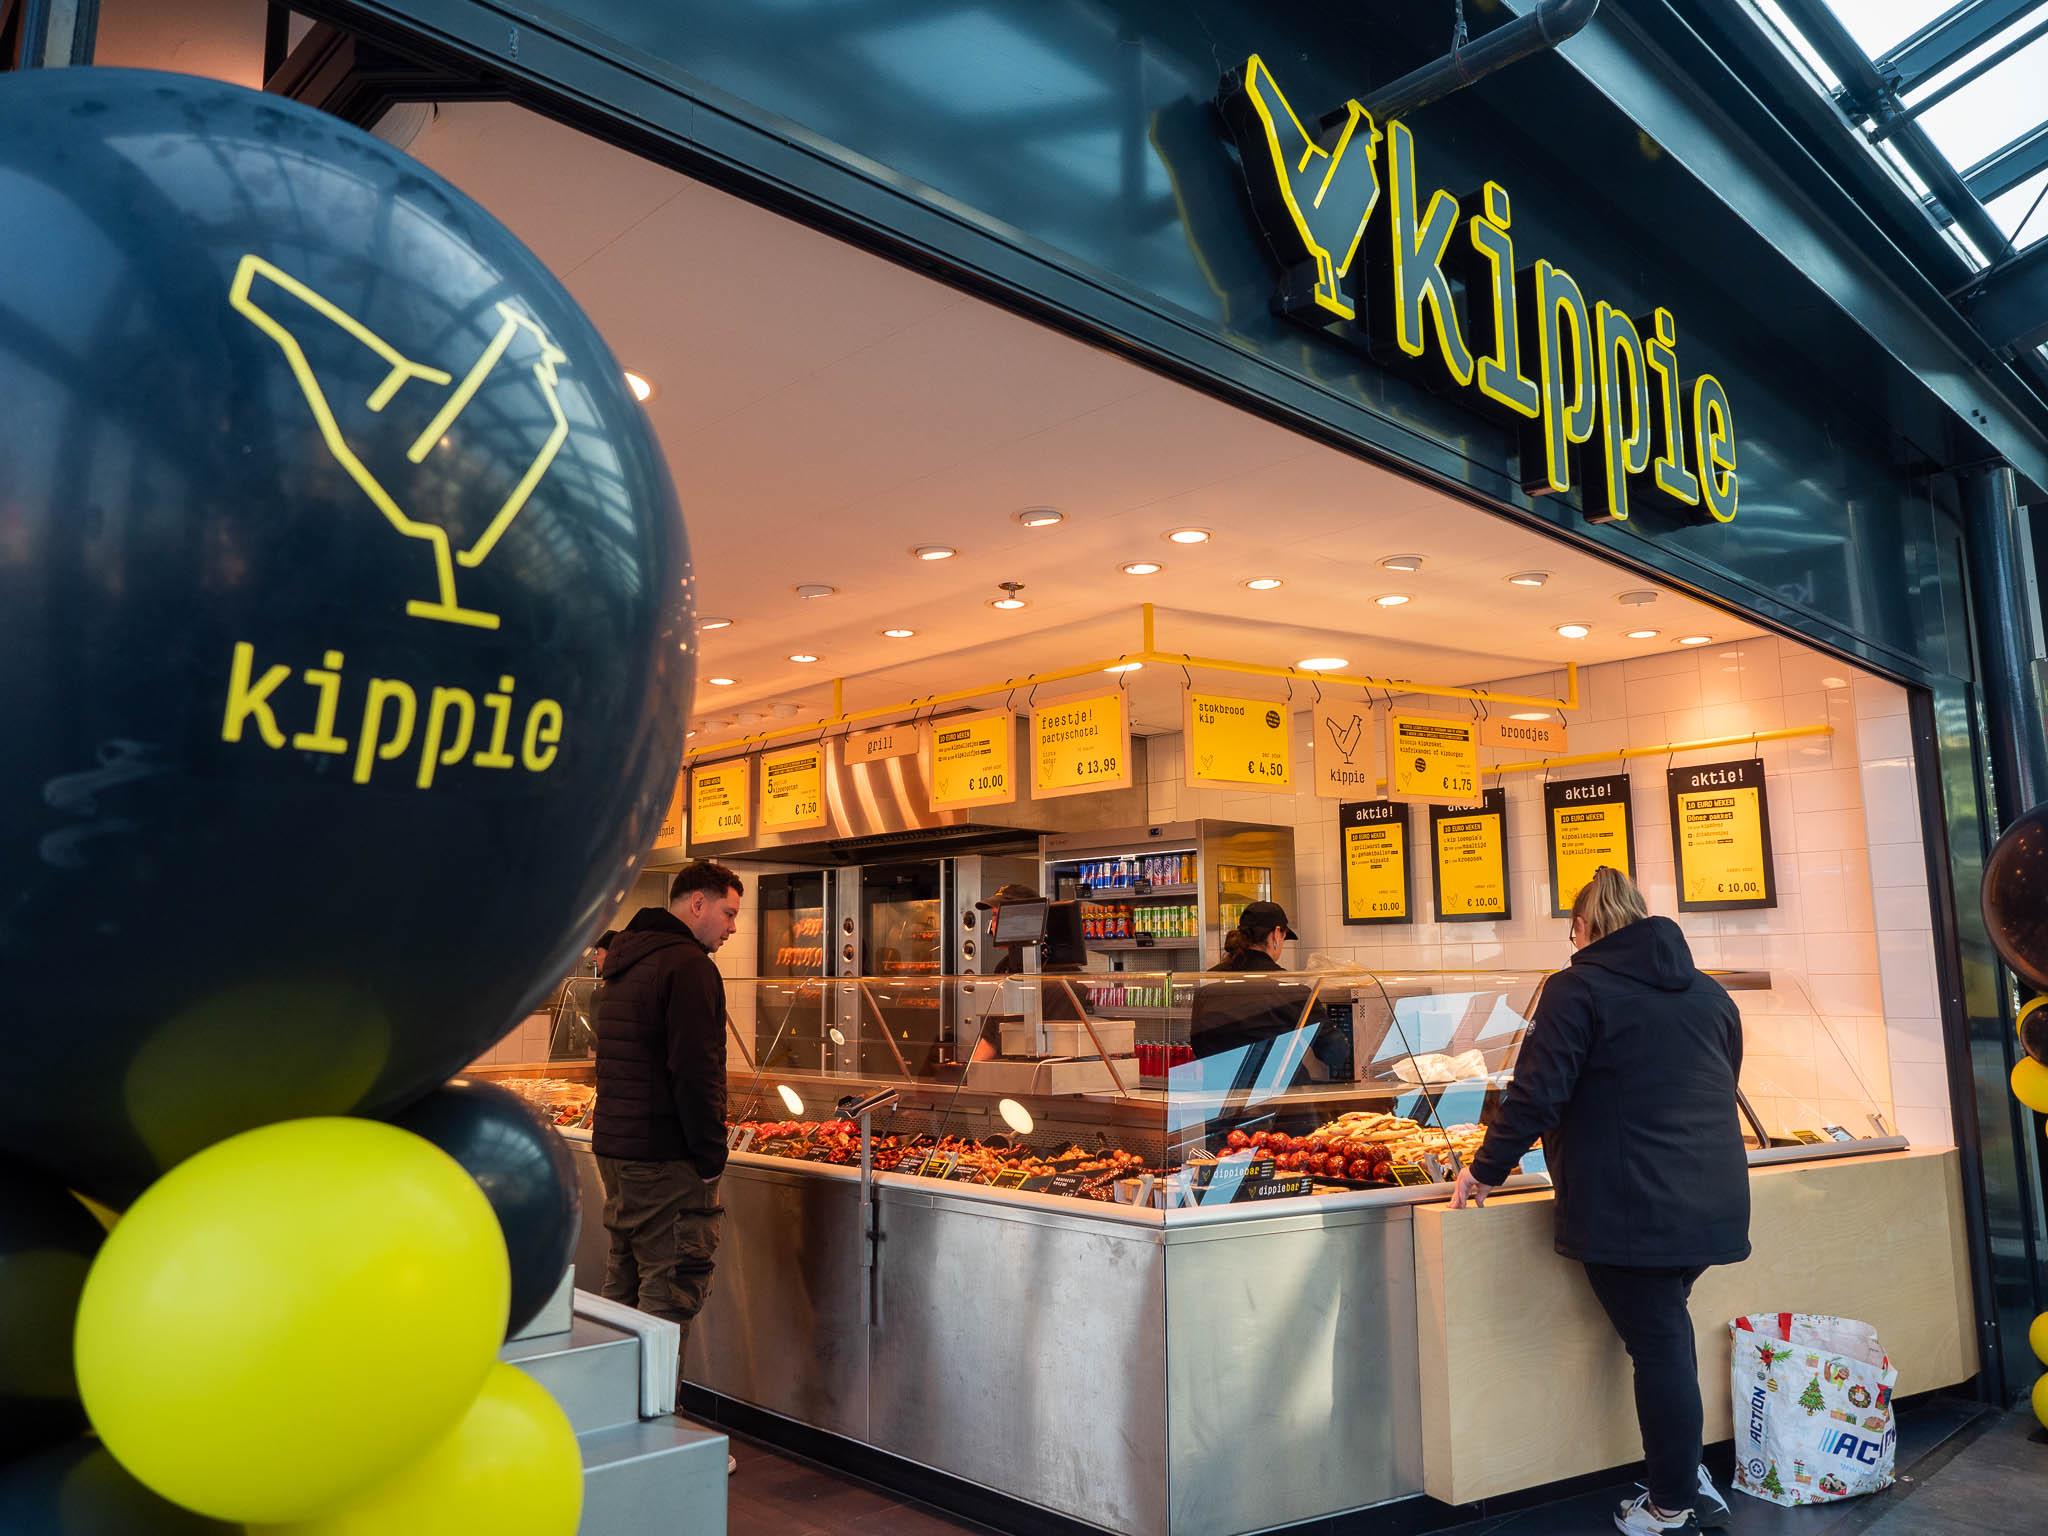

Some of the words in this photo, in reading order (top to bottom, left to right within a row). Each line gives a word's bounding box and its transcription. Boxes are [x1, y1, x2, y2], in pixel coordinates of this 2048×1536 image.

[1387, 120, 1738, 523] kippie
[222, 641, 564, 789] kippie
[1199, 703, 1245, 716] stokbrood
[1041, 709, 1093, 730] feestje!
[1199, 714, 1215, 724] kip
[1041, 725, 1099, 745] partyschotel
[1501, 724, 1550, 742] broodjes
[867, 735, 893, 754] grill
[1076, 761, 1084, 776] €
[1087, 756, 1116, 775] 13,99
[1247, 760, 1255, 774] €
[1259, 761, 1283, 777] 4,50
[969, 778, 975, 790] €
[1330, 769, 1365, 785] kippie
[1442, 776, 1450, 789] €
[1452, 778, 1473, 791] 1,75
[1691, 768, 1745, 787] aktie!
[1565, 783, 1613, 801] aktie!
[795, 803, 800, 815] €
[1687, 802, 1697, 810] 10
[1697, 800, 1713, 809] EURO
[1714, 798, 1735, 807] WEKEN
[1356, 806, 1393, 821] aktie!
[1570, 814, 1585, 823] EURO
[656, 825, 675, 839] ippie
[1451, 824, 1464, 832] EURO
[1718, 883, 1725, 893] €
[1372, 903, 1377, 911] €
[1467, 898, 1473, 907] €
[1213, 1166, 1260, 1179] dippiebar
[1258, 1182, 1300, 1196] dippiebar
[1750, 1385, 1766, 1446] ACTION
